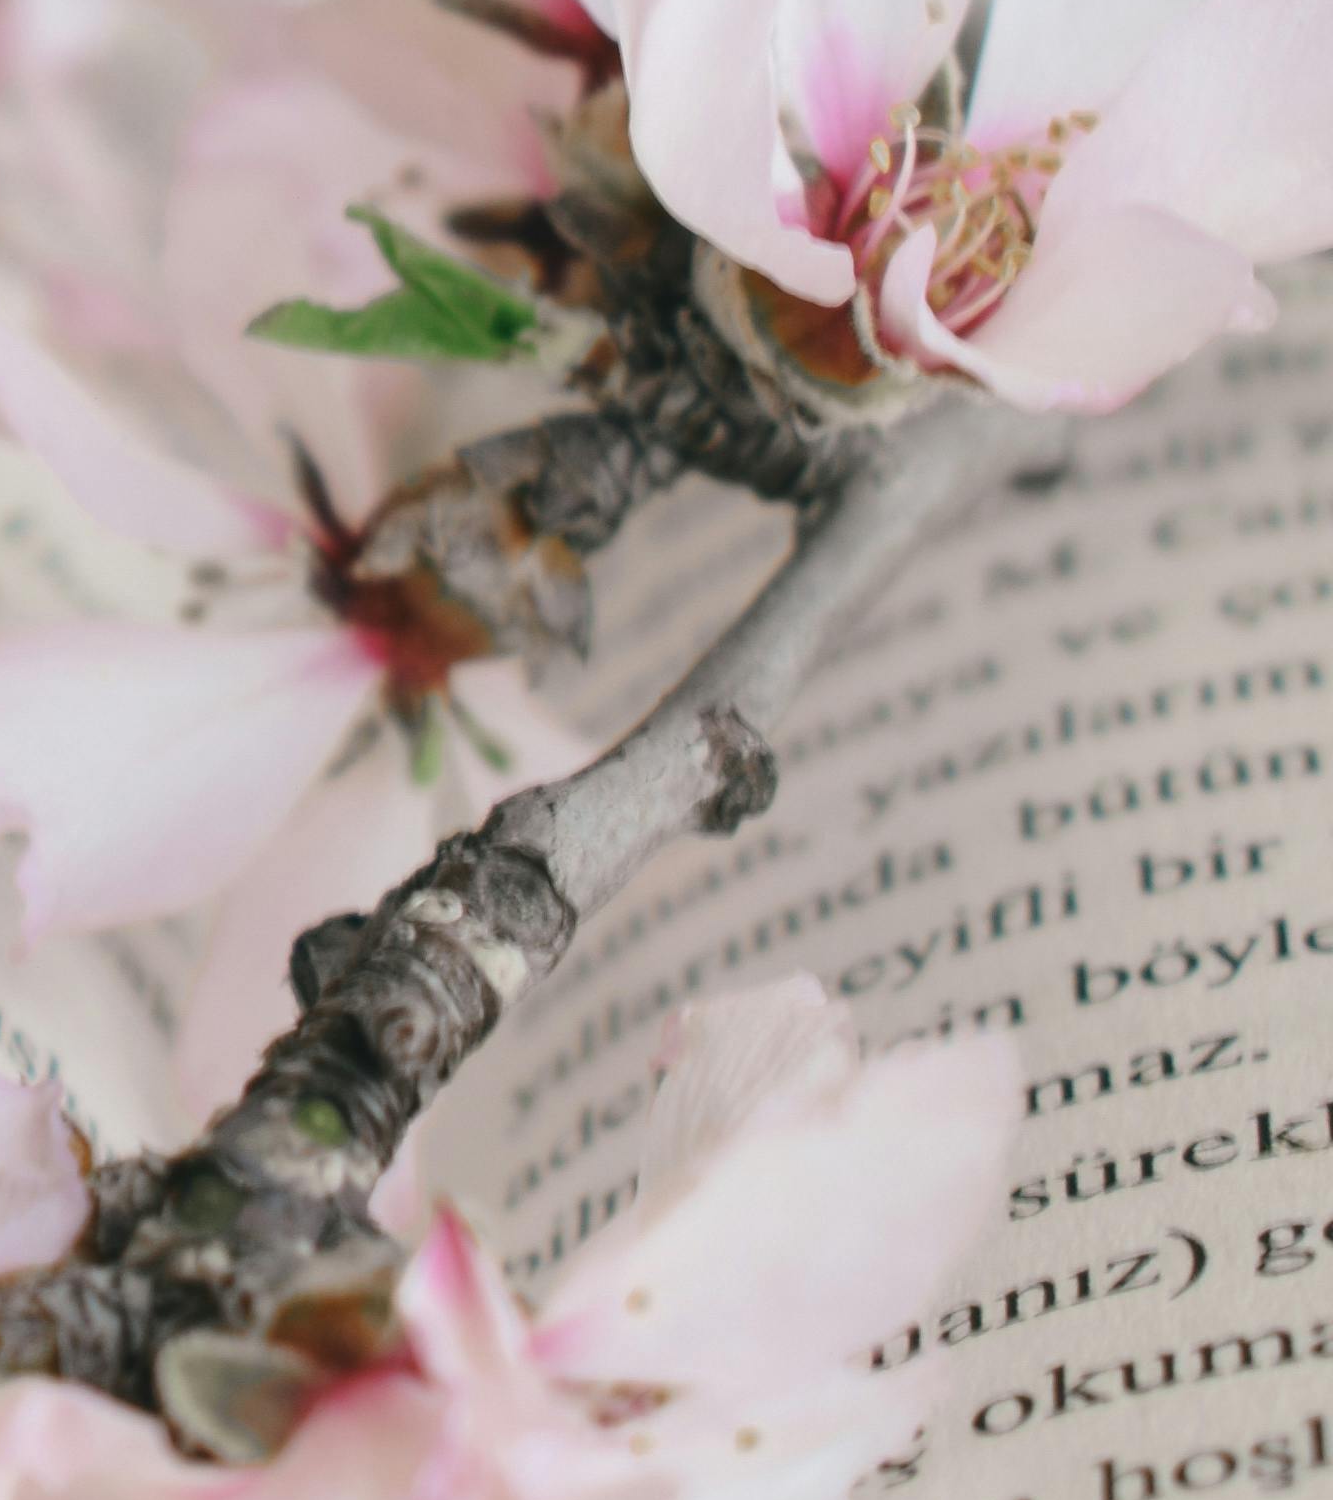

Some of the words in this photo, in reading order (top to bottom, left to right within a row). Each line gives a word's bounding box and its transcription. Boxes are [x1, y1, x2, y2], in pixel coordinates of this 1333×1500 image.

[1016, 740, 1328, 845] bütün
[833, 870, 1083, 1000] eyifli
[1136, 835, 1278, 900] bir
[1023, 1030, 1271, 1120] maz.
